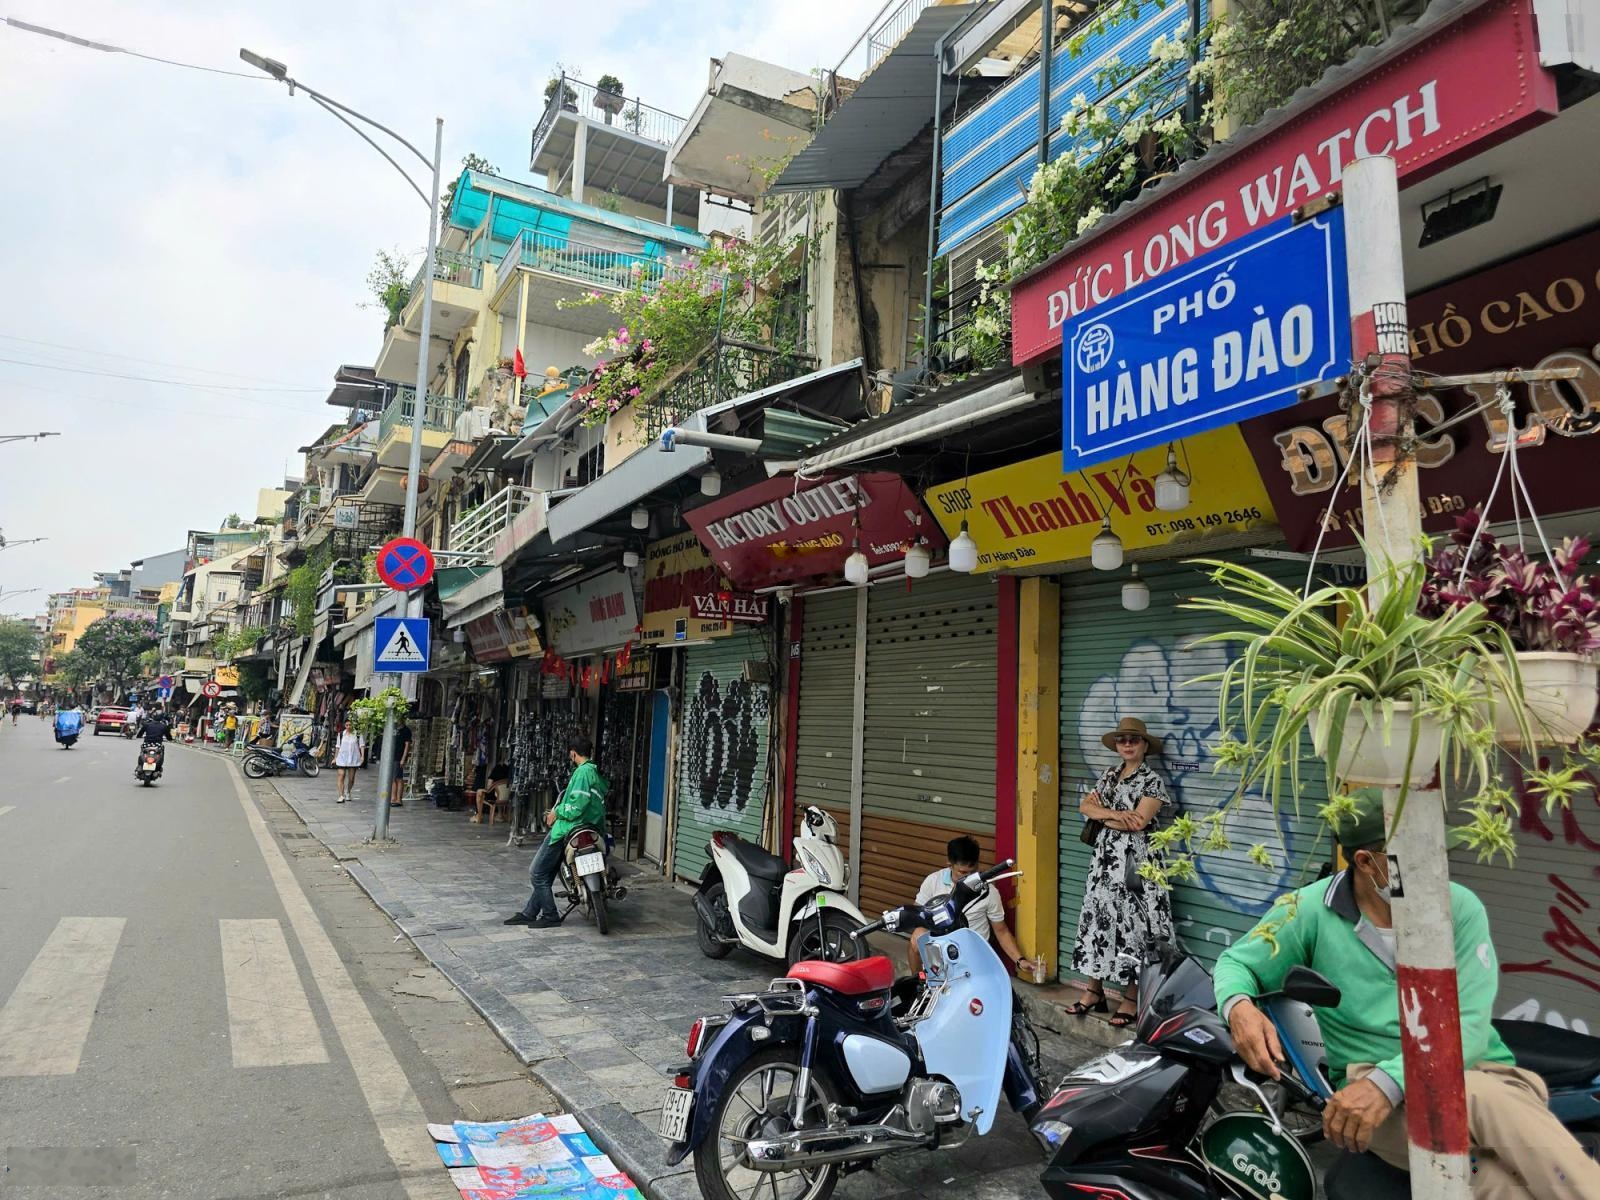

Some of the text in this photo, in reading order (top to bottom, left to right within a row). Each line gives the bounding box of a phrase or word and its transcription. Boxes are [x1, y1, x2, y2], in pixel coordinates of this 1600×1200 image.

[1047, 79, 1441, 331] ĐỨC LONG WATCH
[1152, 260, 1237, 336] PHỐ
[1480, 278, 1585, 335] CAO
[1086, 303, 1314, 436] HÀNG ĐÀO
[705, 474, 868, 549] FACTORY OUTLET
[937, 487, 974, 515] SHOP
[980, 463, 1161, 540] Thanh Vâ
[1170, 517, 1196, 534] 098
[1197, 512, 1223, 530] 149
[1223, 506, 1263, 525] 2646
[693, 592, 730, 612] VÂN
[1232, 1153, 1281, 1193] Grab
